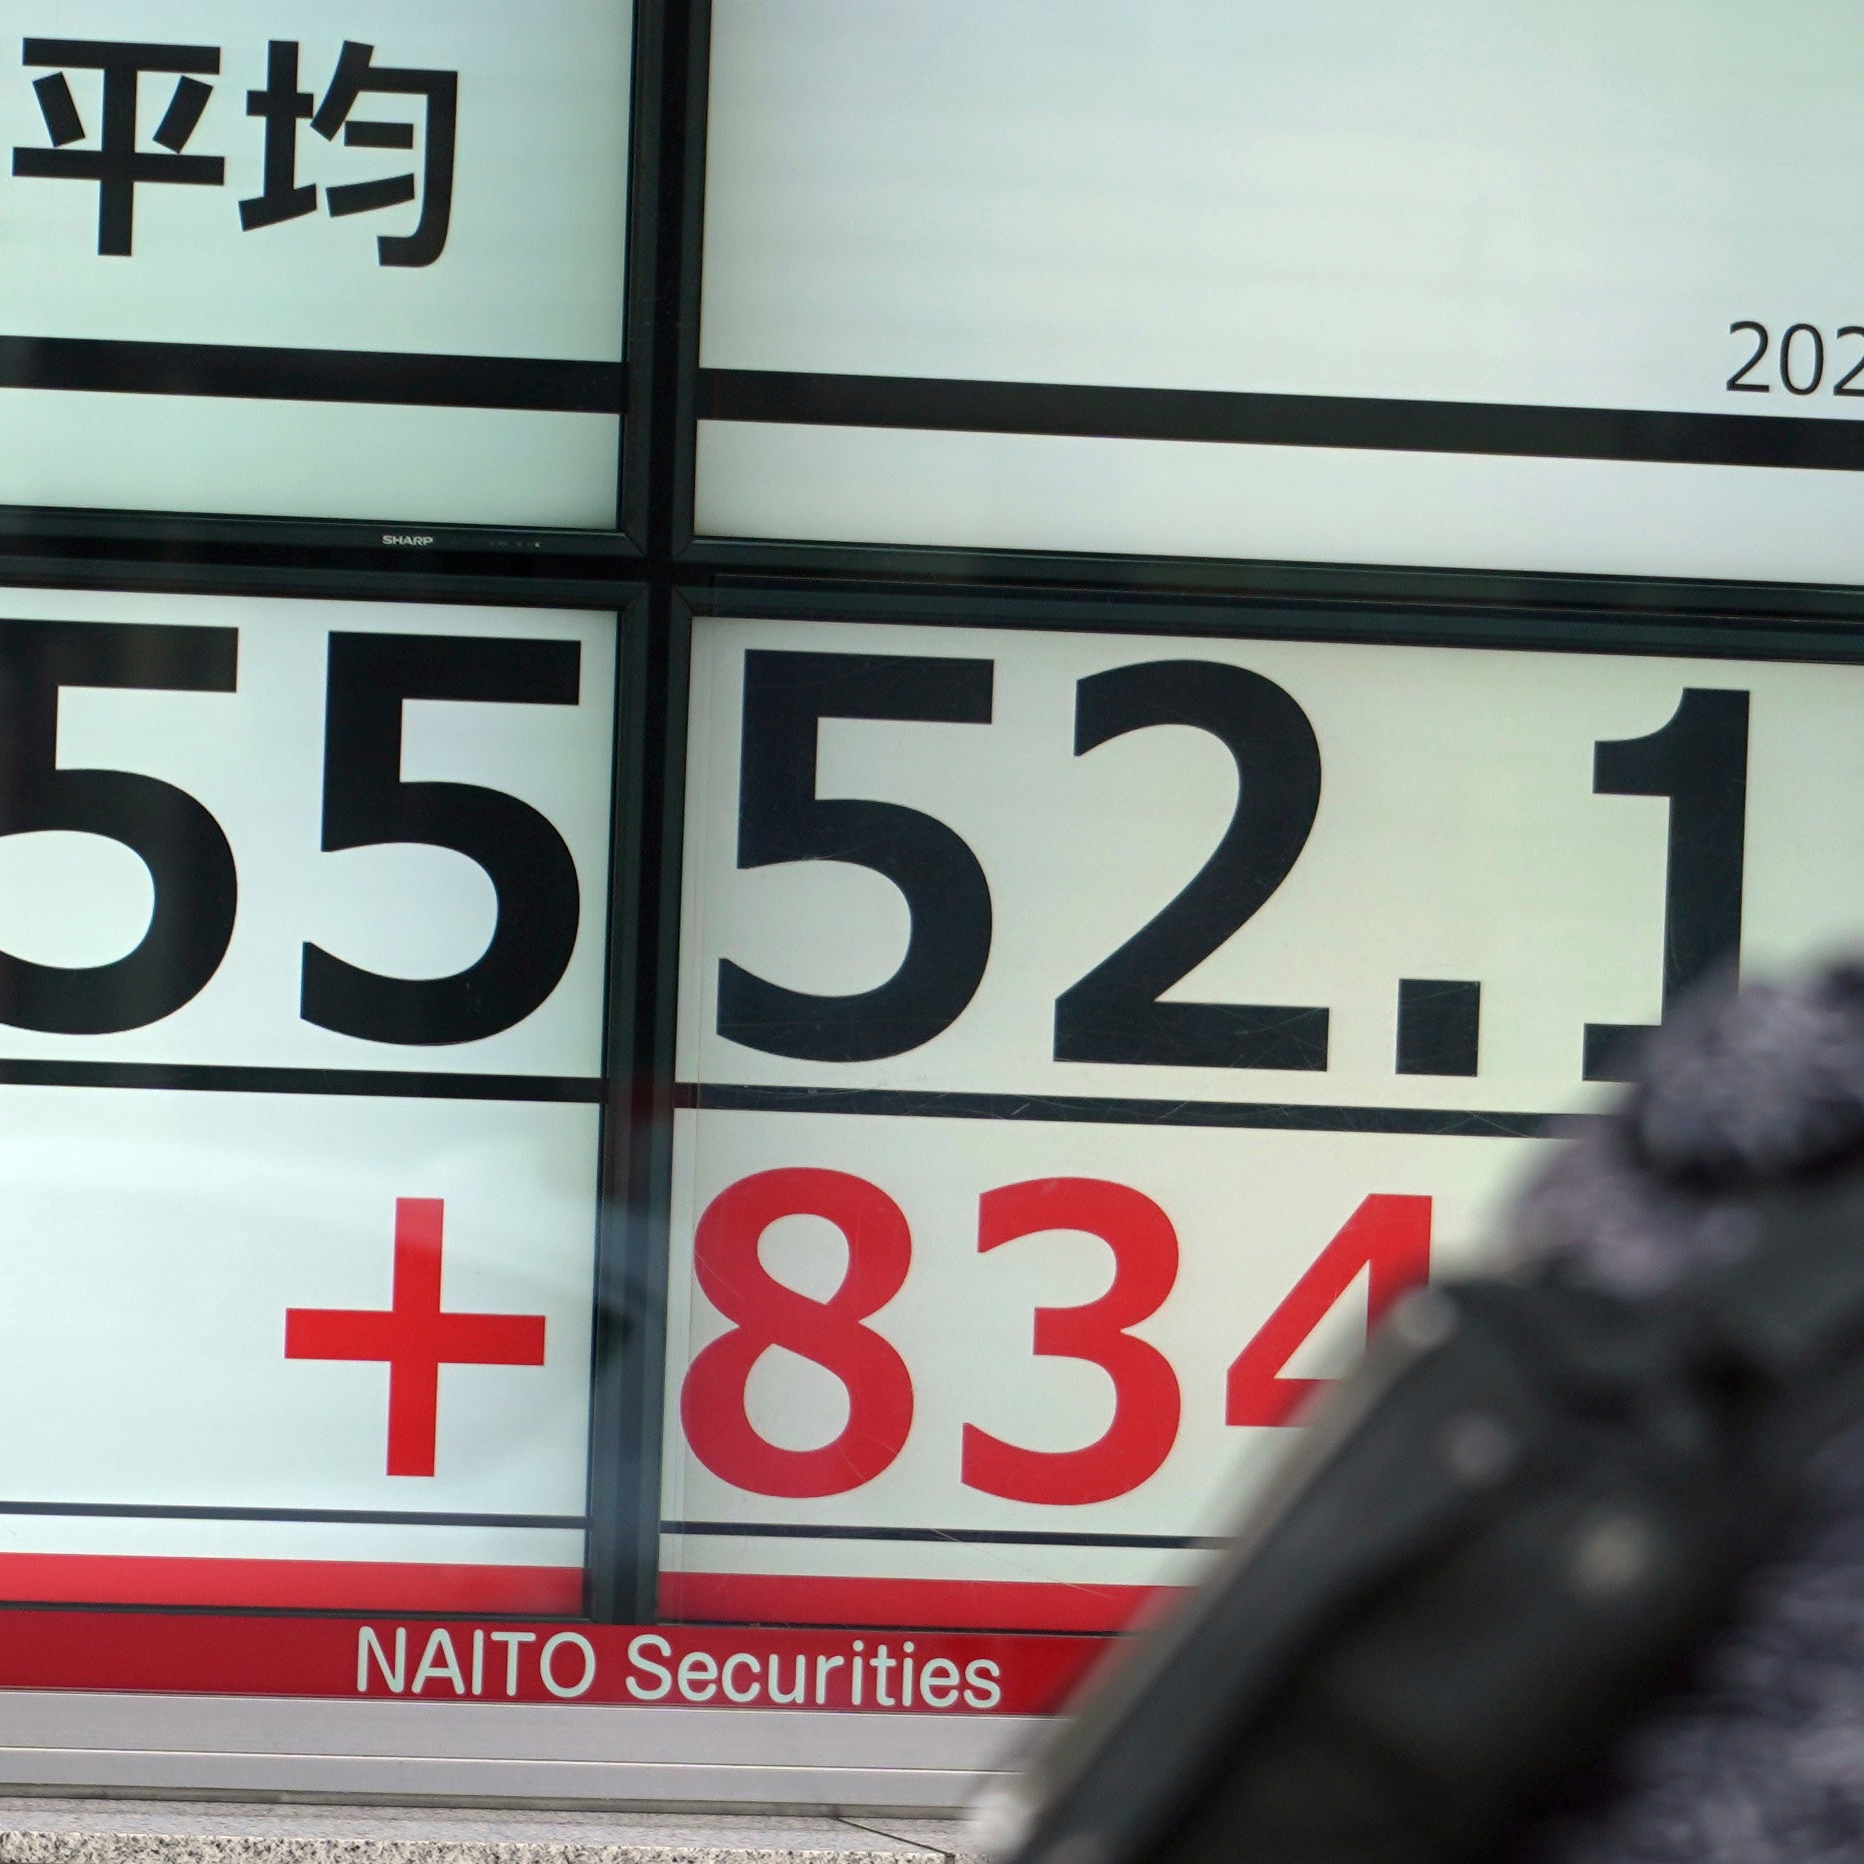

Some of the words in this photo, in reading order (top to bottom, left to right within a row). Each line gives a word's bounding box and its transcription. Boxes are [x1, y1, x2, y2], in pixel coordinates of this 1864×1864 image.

[382, 534, 434, 547] SHARP
[356, 1625, 597, 1699] NAITO
[624, 1633, 1003, 1709] Securities
